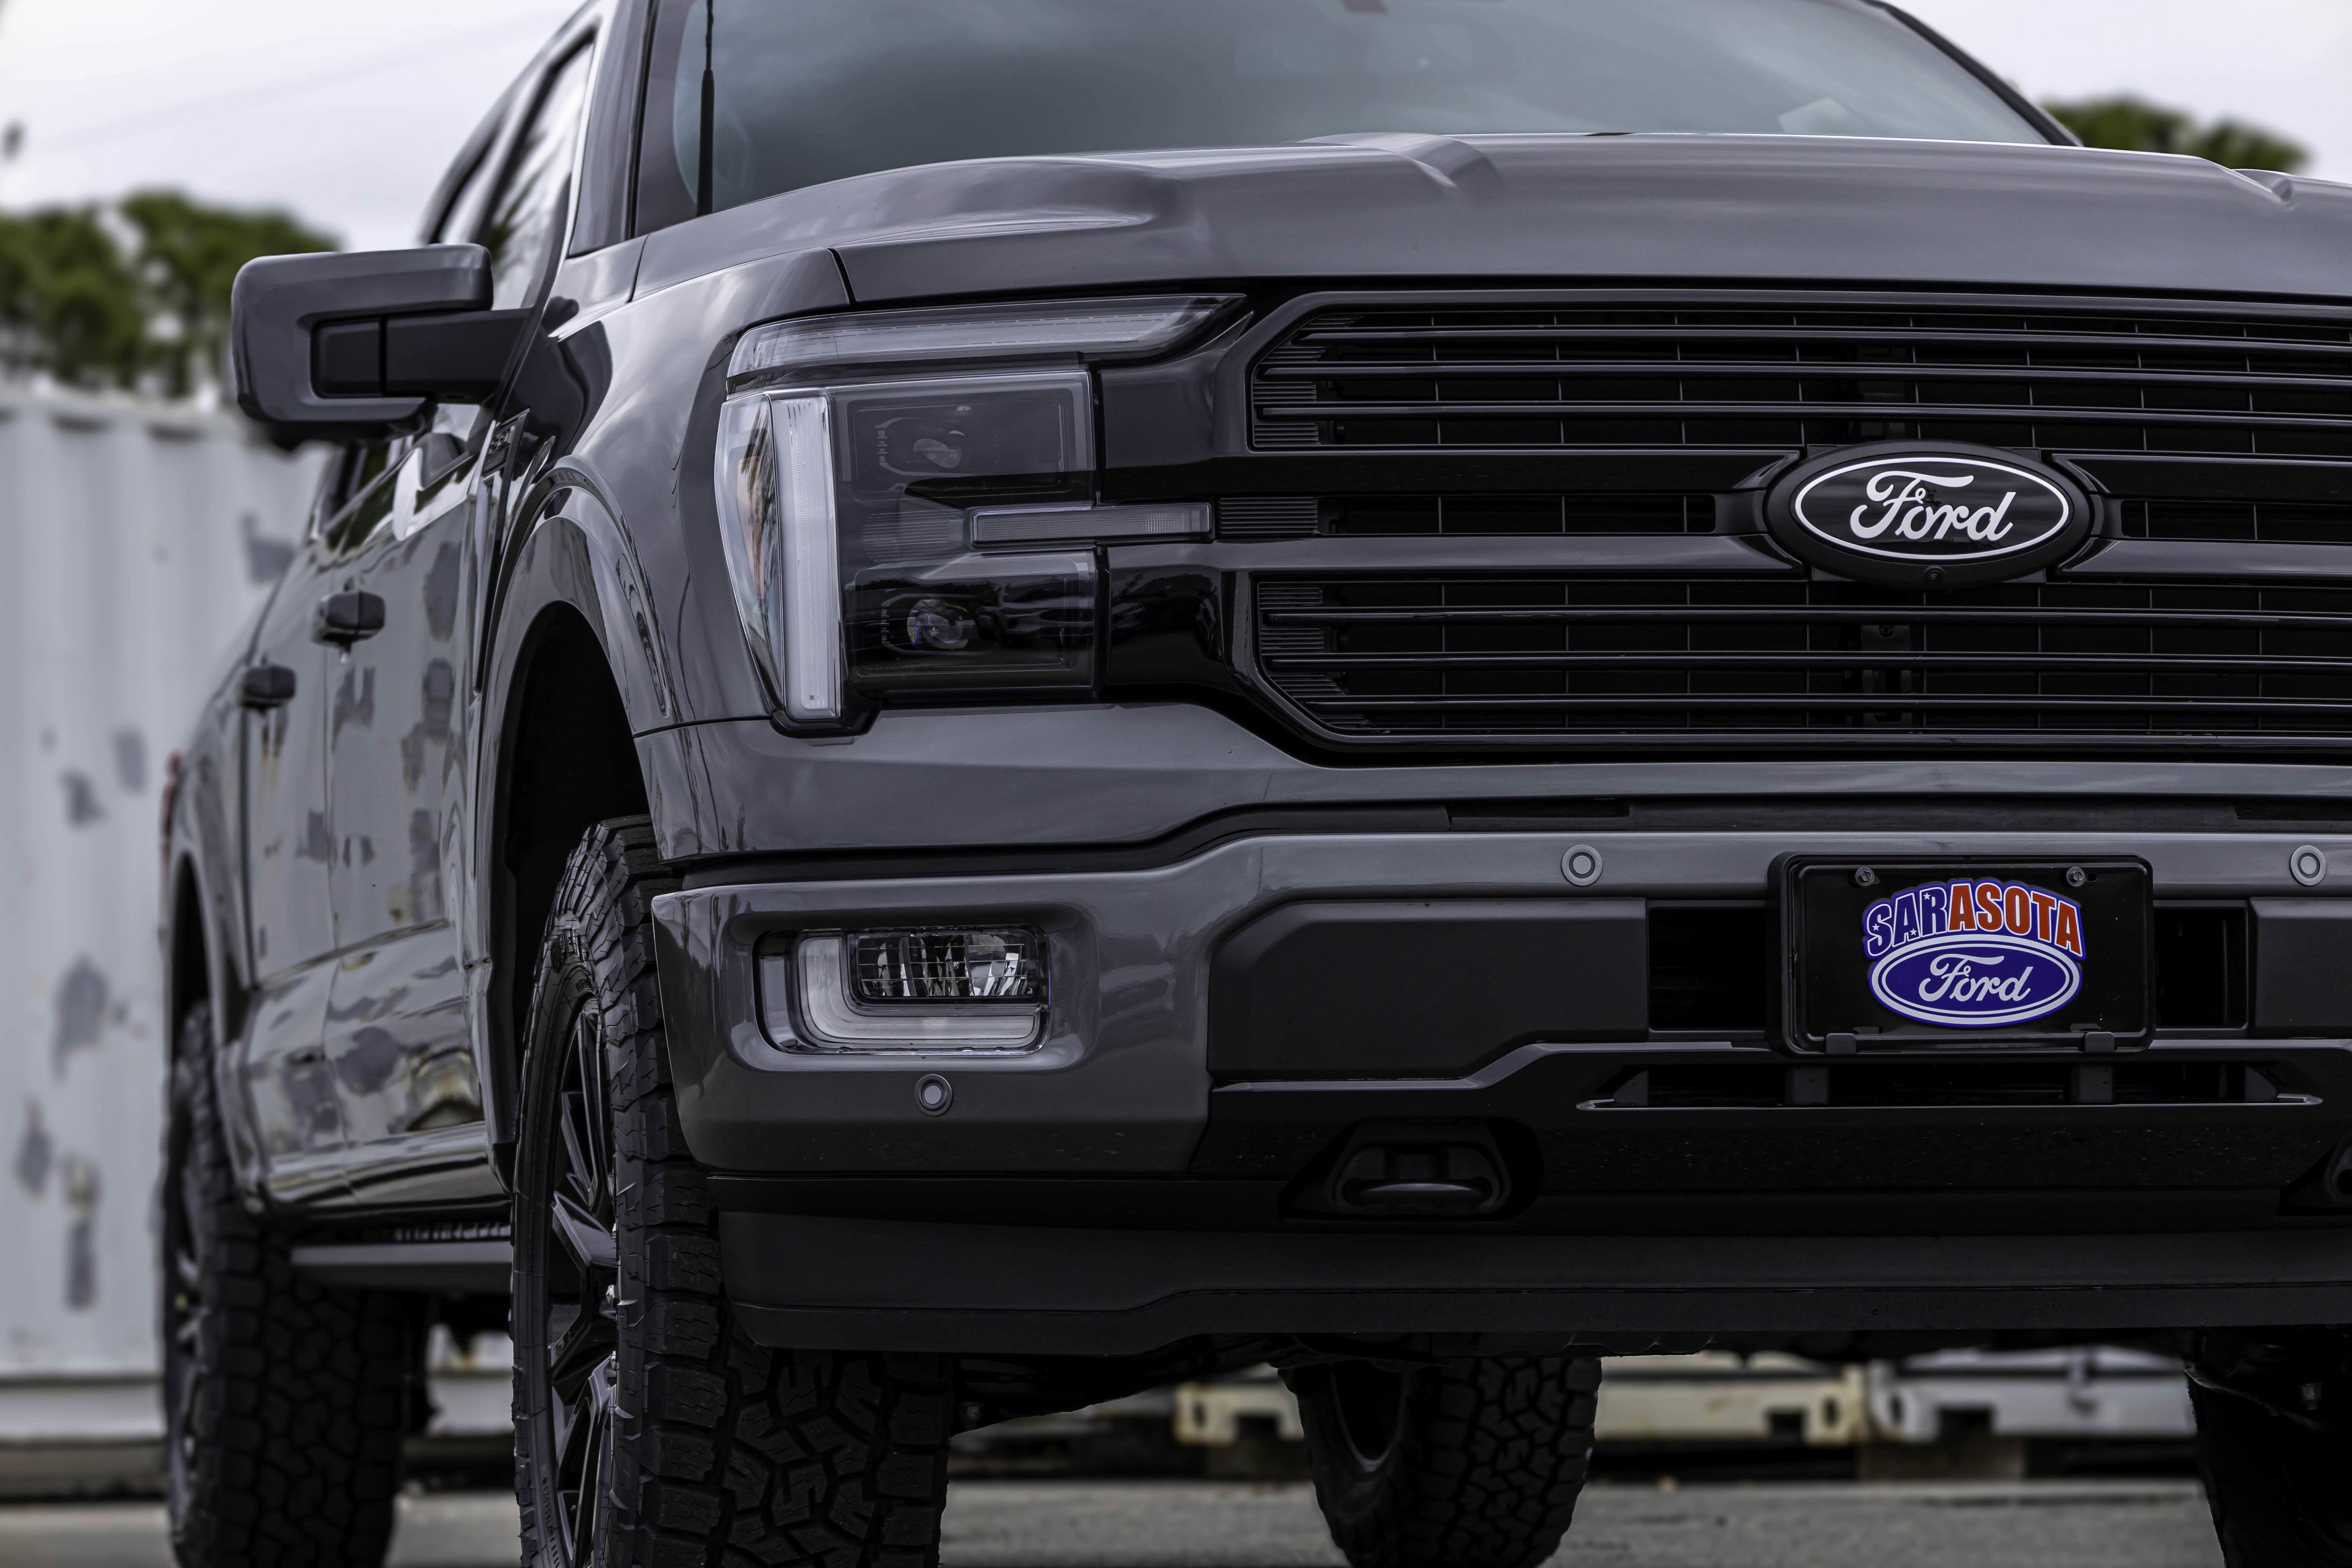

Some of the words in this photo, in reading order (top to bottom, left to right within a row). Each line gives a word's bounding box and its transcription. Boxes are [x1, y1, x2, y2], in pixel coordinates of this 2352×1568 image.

[1850, 470, 2017, 541] Ford
[1866, 882, 2083, 958] SARASOTA
[1919, 953, 2034, 1002] Ford
